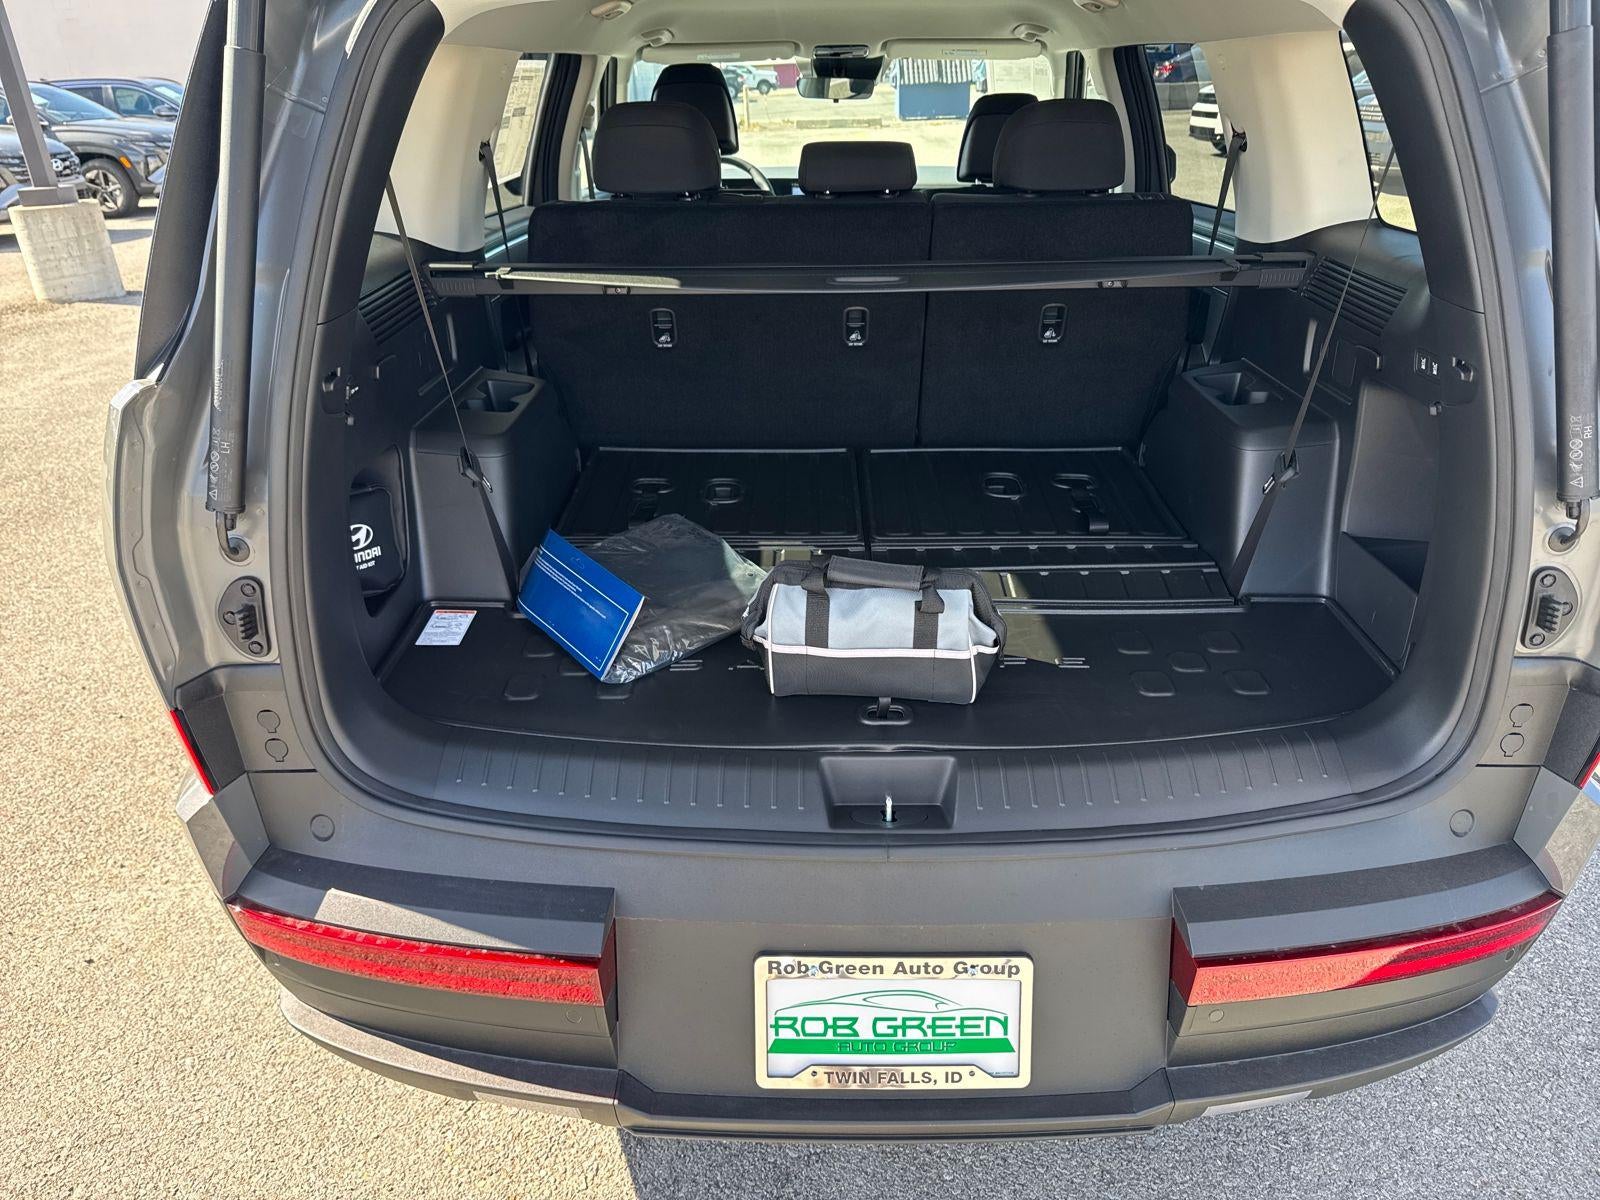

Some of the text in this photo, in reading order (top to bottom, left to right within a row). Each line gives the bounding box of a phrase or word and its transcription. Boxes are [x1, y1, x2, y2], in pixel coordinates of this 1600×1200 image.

[1583, 425, 1592, 439] RH
[220, 441, 231, 454] LH
[767, 960, 1020, 978] Rob Green Auto Group
[770, 1015, 1009, 1038] ROB GREEN
[837, 1041, 957, 1053] AUTO GROUP
[823, 1071, 963, 1086] TWIN FALLS, ID
